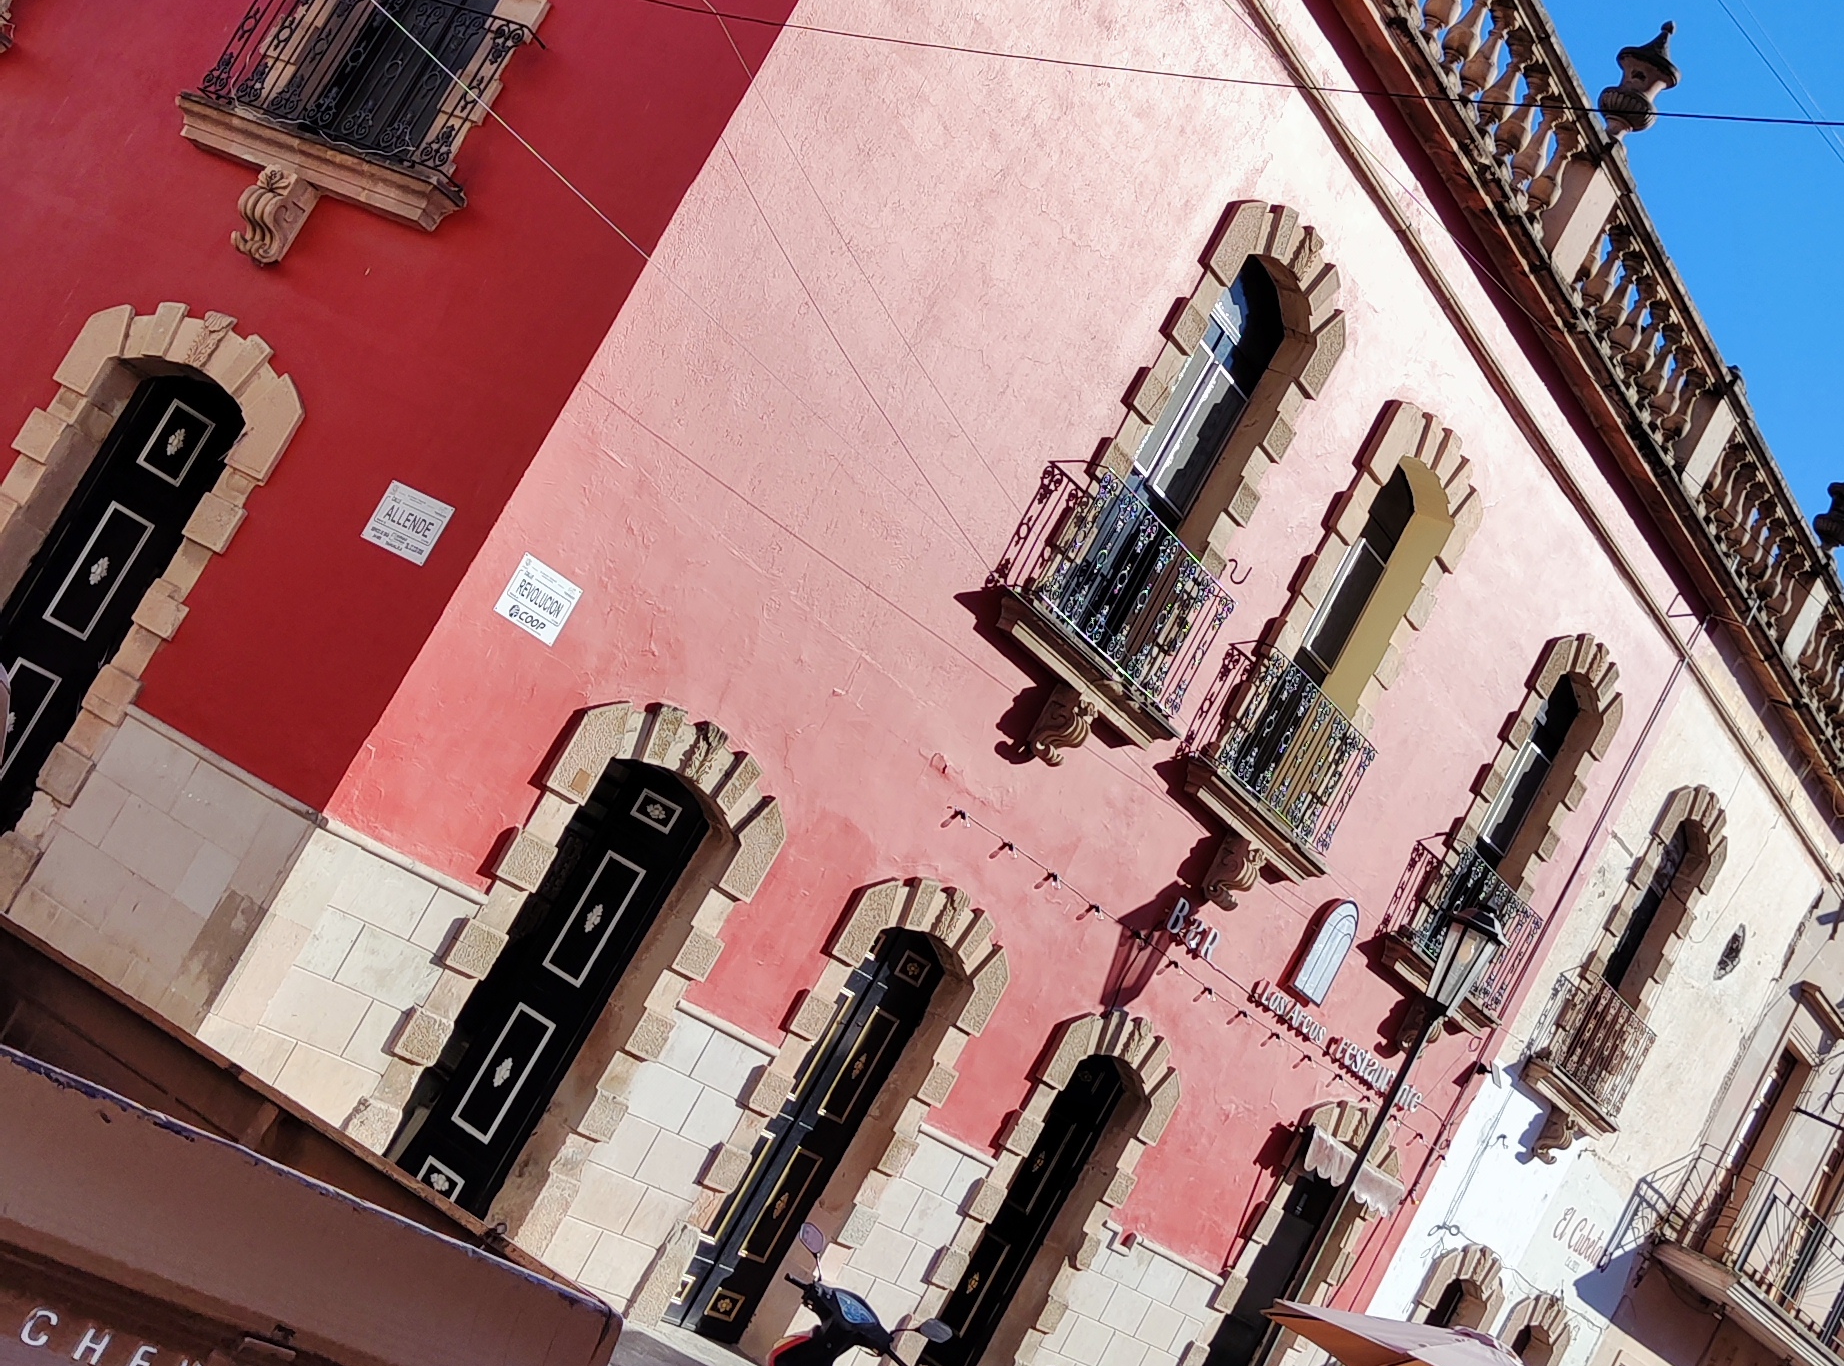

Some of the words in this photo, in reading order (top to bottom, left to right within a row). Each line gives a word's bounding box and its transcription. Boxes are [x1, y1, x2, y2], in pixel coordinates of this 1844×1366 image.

[383, 505, 434, 538] ALLENDE
[516, 579, 564, 618] REVOLUCION
[519, 611, 546, 630] COOP
[1336, 1038, 1423, 1113] restaurnte
[1553, 1207, 1576, 1241] El
